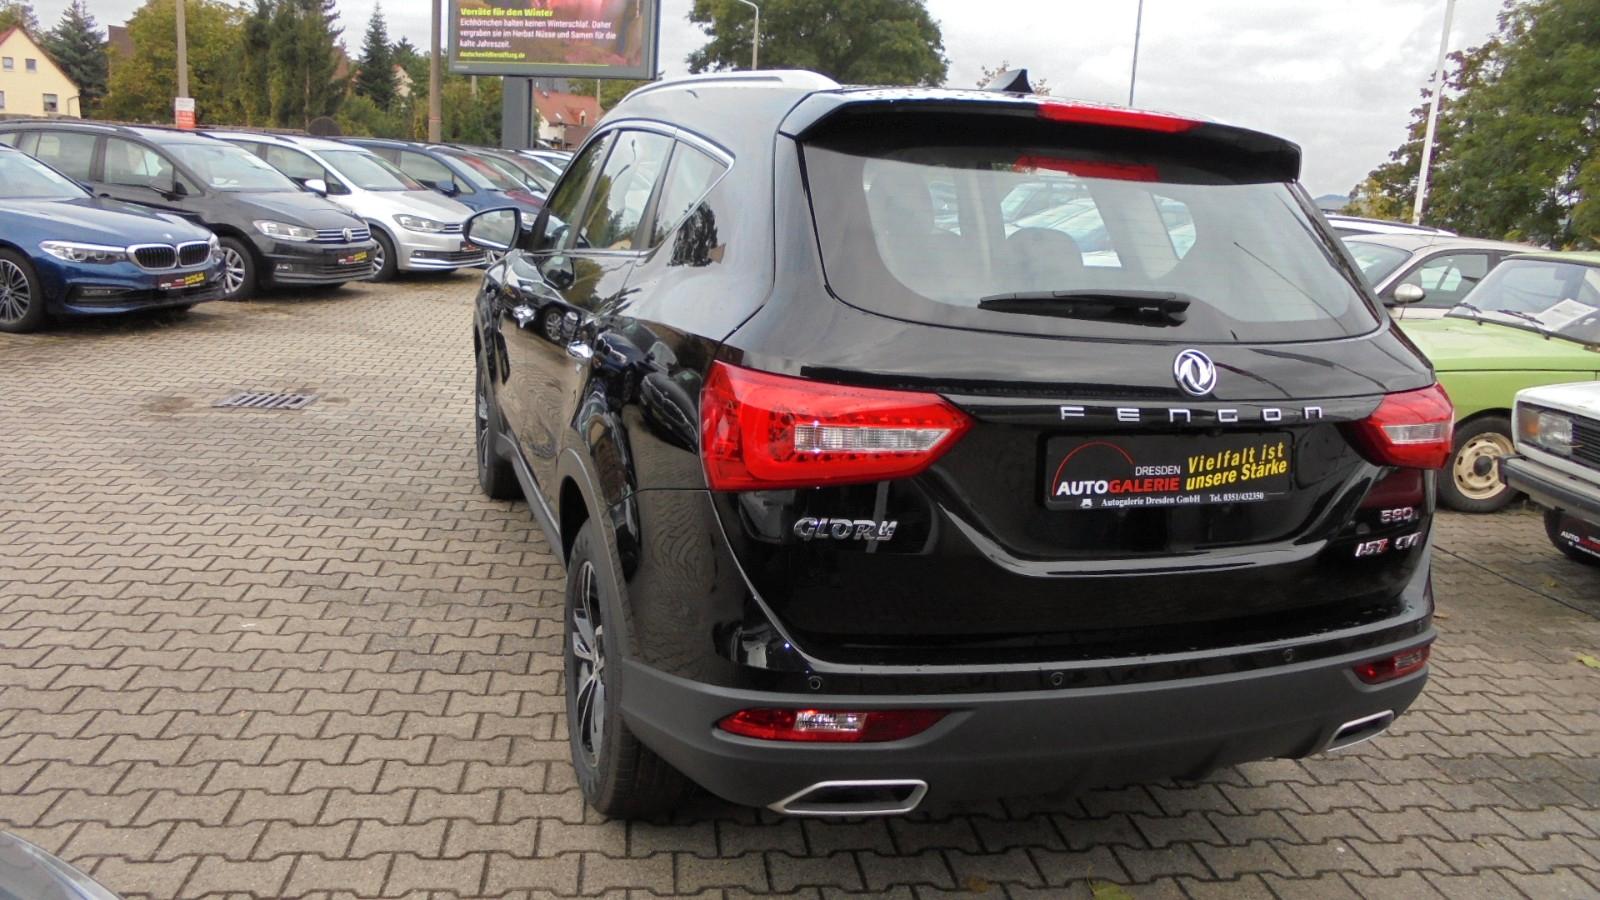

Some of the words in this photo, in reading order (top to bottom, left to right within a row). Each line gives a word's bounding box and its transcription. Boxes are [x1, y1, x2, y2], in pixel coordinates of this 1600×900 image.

[460, 8, 491, 16] Vorräte
[492, 8, 505, 16] für
[506, 8, 523, 16] den
[524, 8, 553, 17] Winter
[460, 18, 502, 26] Eichhörnchen
[503, 19, 524, 27] halten
[525, 19, 546, 27] keinen
[547, 19, 589, 28] Winterschlaf.
[592, 21, 612, 29] Daher
[460, 30, 491, 38] vergraben
[512, 30, 534, 38] Herbst
[535, 30, 556, 38] Nüsse
[571, 31, 593, 39] Samen
[594, 31, 604, 39] für
[605, 32, 616, 40] die
[477, 40, 512, 48] Jahreszeit.
[1188, 447, 1255, 474] Vielfalt
[1261, 442, 1284, 461] ist
[1135, 465, 1181, 476] DRESDEN
[1186, 469, 1238, 491] unsere
[1240, 459, 1287, 481] Stärke
[1101, 496, 1144, 507] Autogalerie
[1145, 495, 1176, 506] Dresden
[1176, 494, 1200, 504] GmbH
[1209, 494, 1222, 502] Tel.
[794, 516, 898, 541] GLORY
